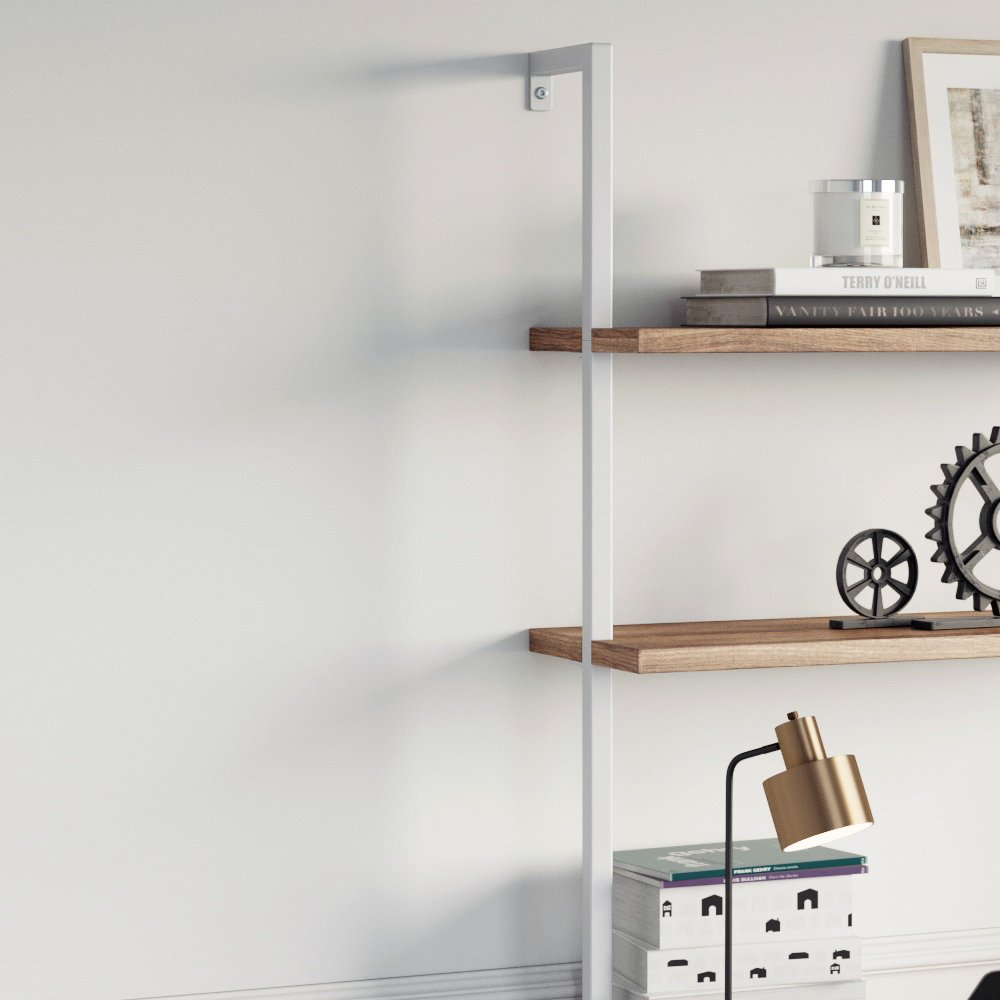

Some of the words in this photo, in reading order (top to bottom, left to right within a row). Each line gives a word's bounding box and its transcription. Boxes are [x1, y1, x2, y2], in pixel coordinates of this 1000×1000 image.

[841, 275, 880, 289] TERRY
[884, 275, 927, 289] O'NEILL
[775, 305, 840, 317] VANITY
[848, 306, 888, 317] FAIR
[892, 306, 924, 317] 100
[929, 306, 984, 317] YEARS
